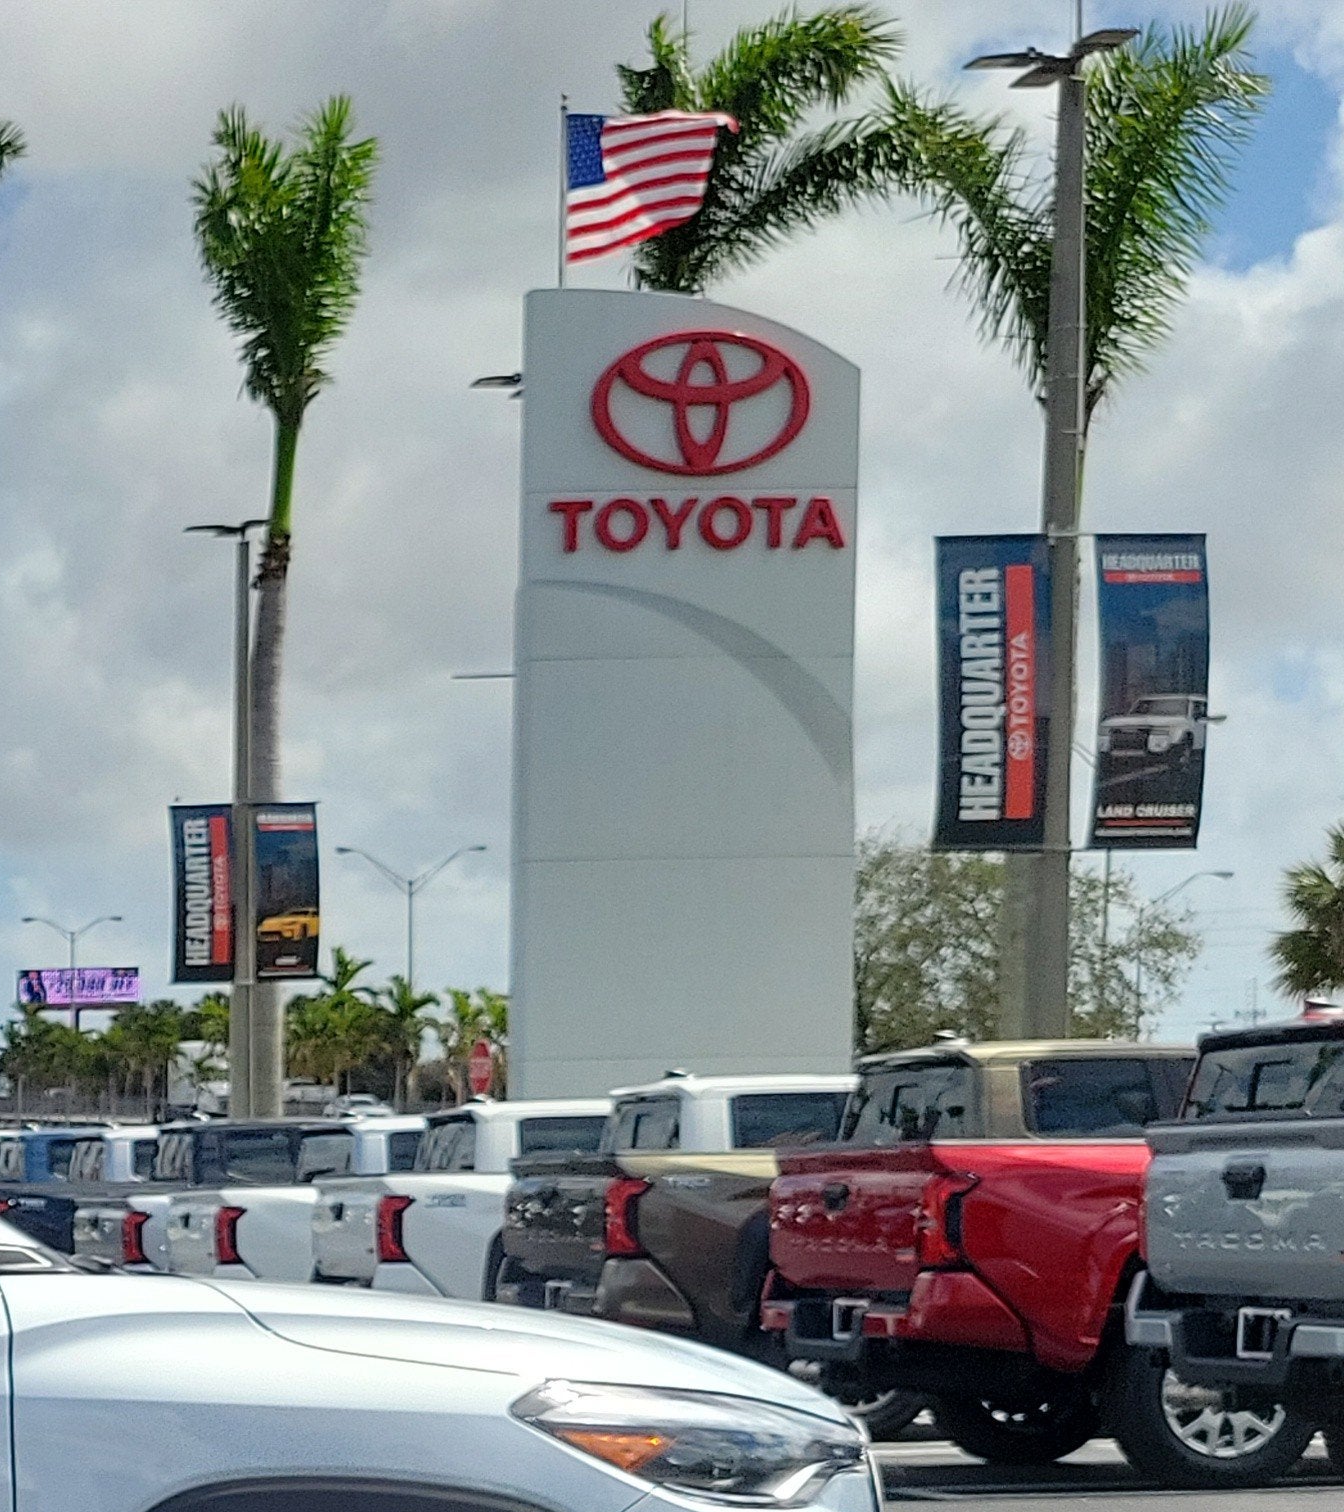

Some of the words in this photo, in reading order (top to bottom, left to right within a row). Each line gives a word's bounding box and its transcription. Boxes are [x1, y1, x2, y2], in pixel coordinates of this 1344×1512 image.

[547, 496, 845, 553] TOYOTA
[958, 566, 1006, 822] HEADQUARTER
[1010, 629, 1030, 728] TOYOTA
[1096, 803, 1135, 818] LAND
[1135, 802, 1195, 818] CRUISER
[183, 818, 213, 966] HEADQUARTER
[1173, 1231, 1326, 1251] TACOMA
